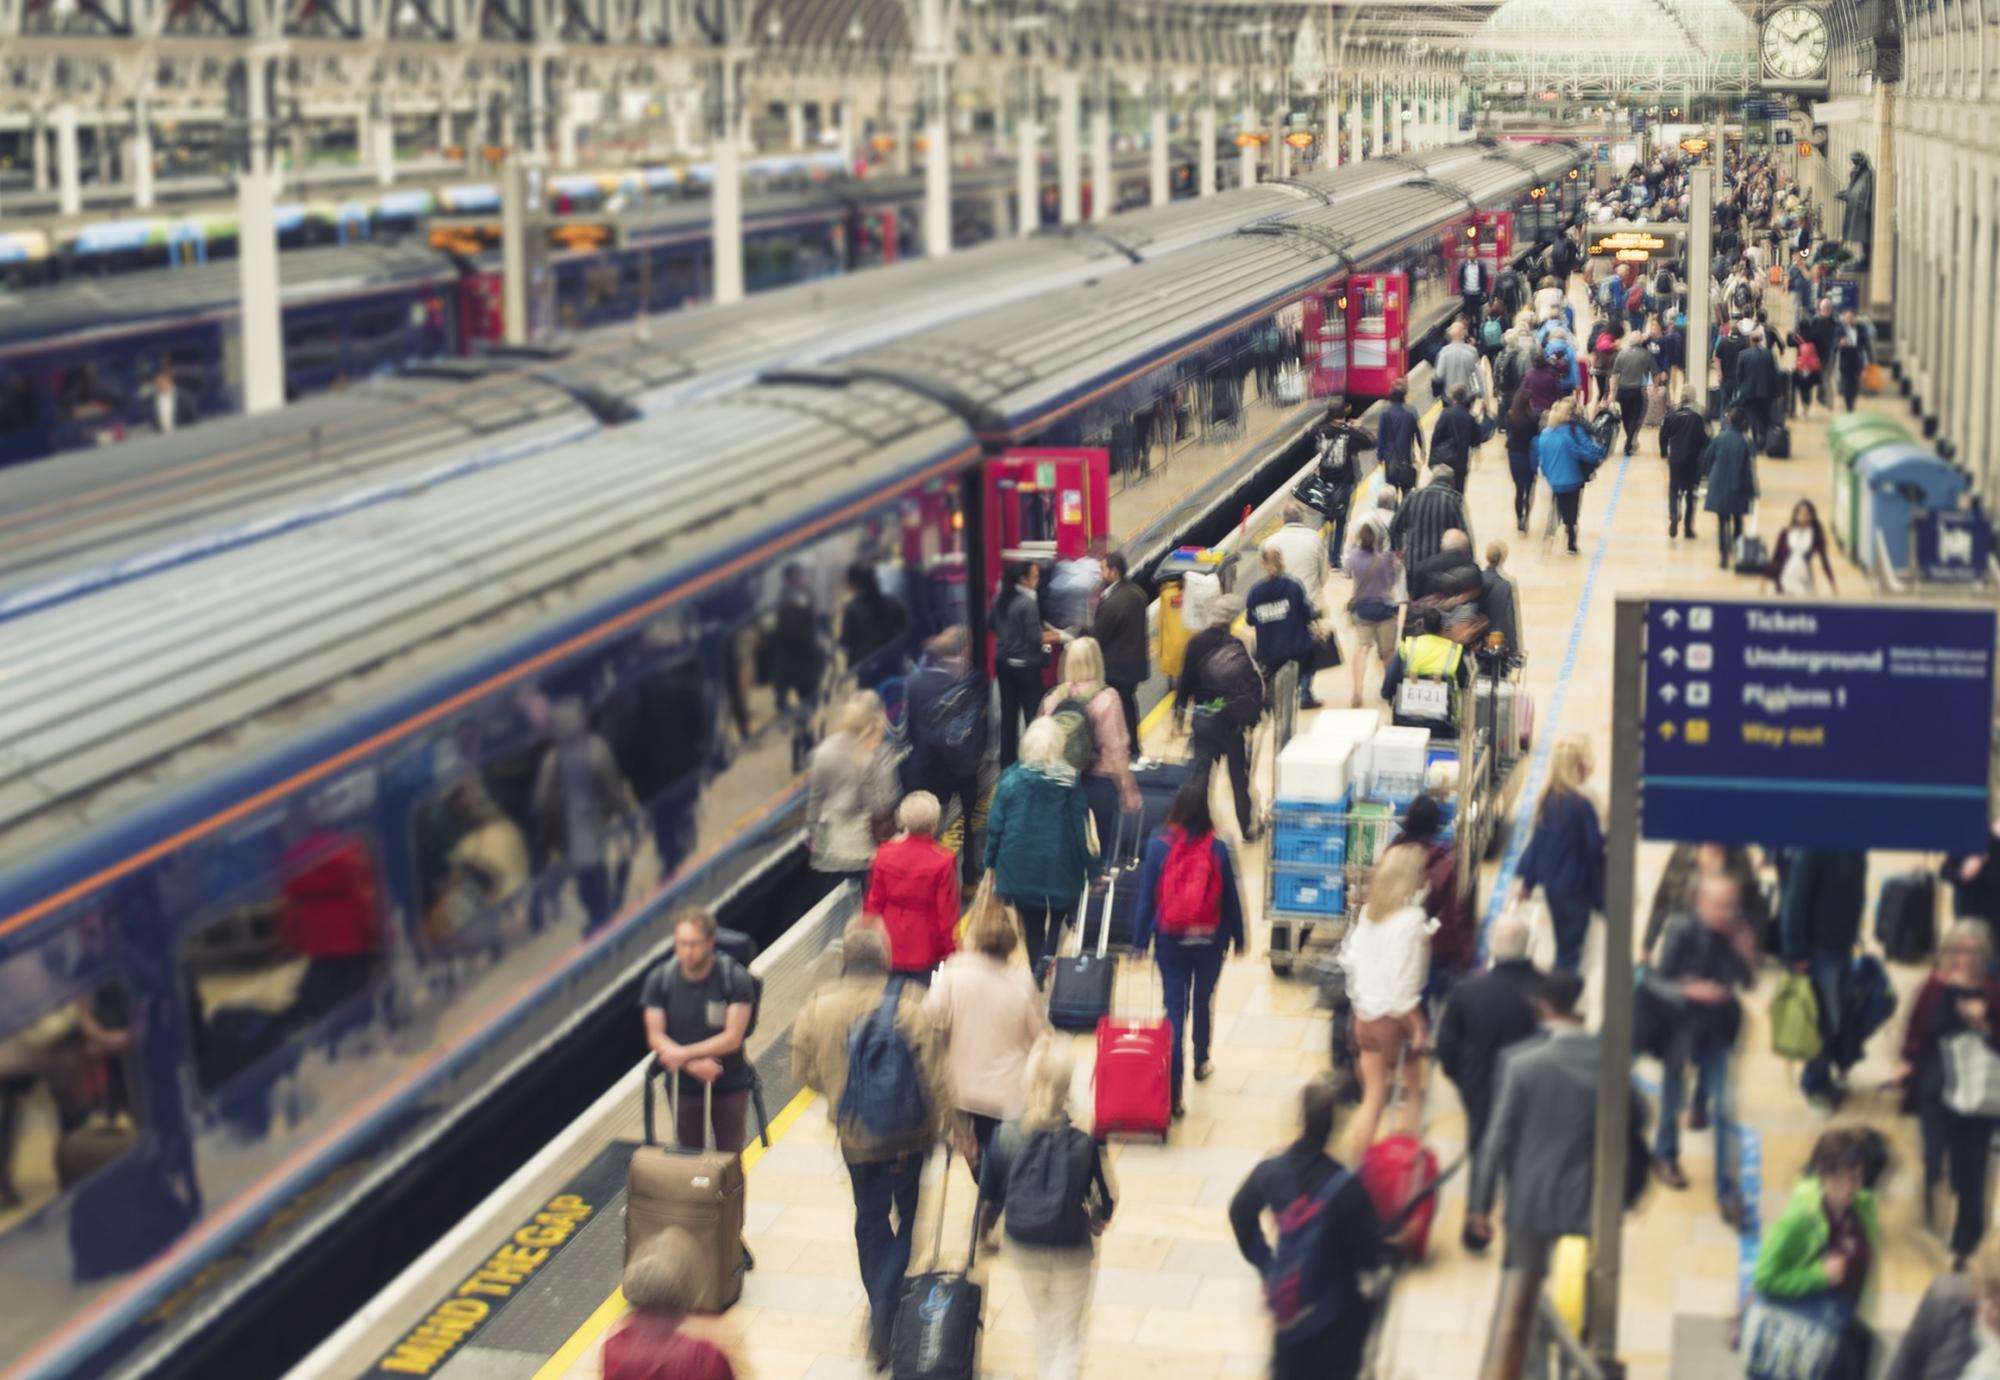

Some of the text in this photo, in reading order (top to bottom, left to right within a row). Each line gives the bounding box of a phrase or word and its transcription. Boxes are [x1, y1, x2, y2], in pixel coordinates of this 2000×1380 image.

[1745, 609, 1817, 634] Tickets
[1744, 646, 1883, 674] Underground
[1836, 686, 1848, 709] 1
[1741, 721, 1825, 748] Way out
[379, 1193, 593, 1375] MIND THE GAP
